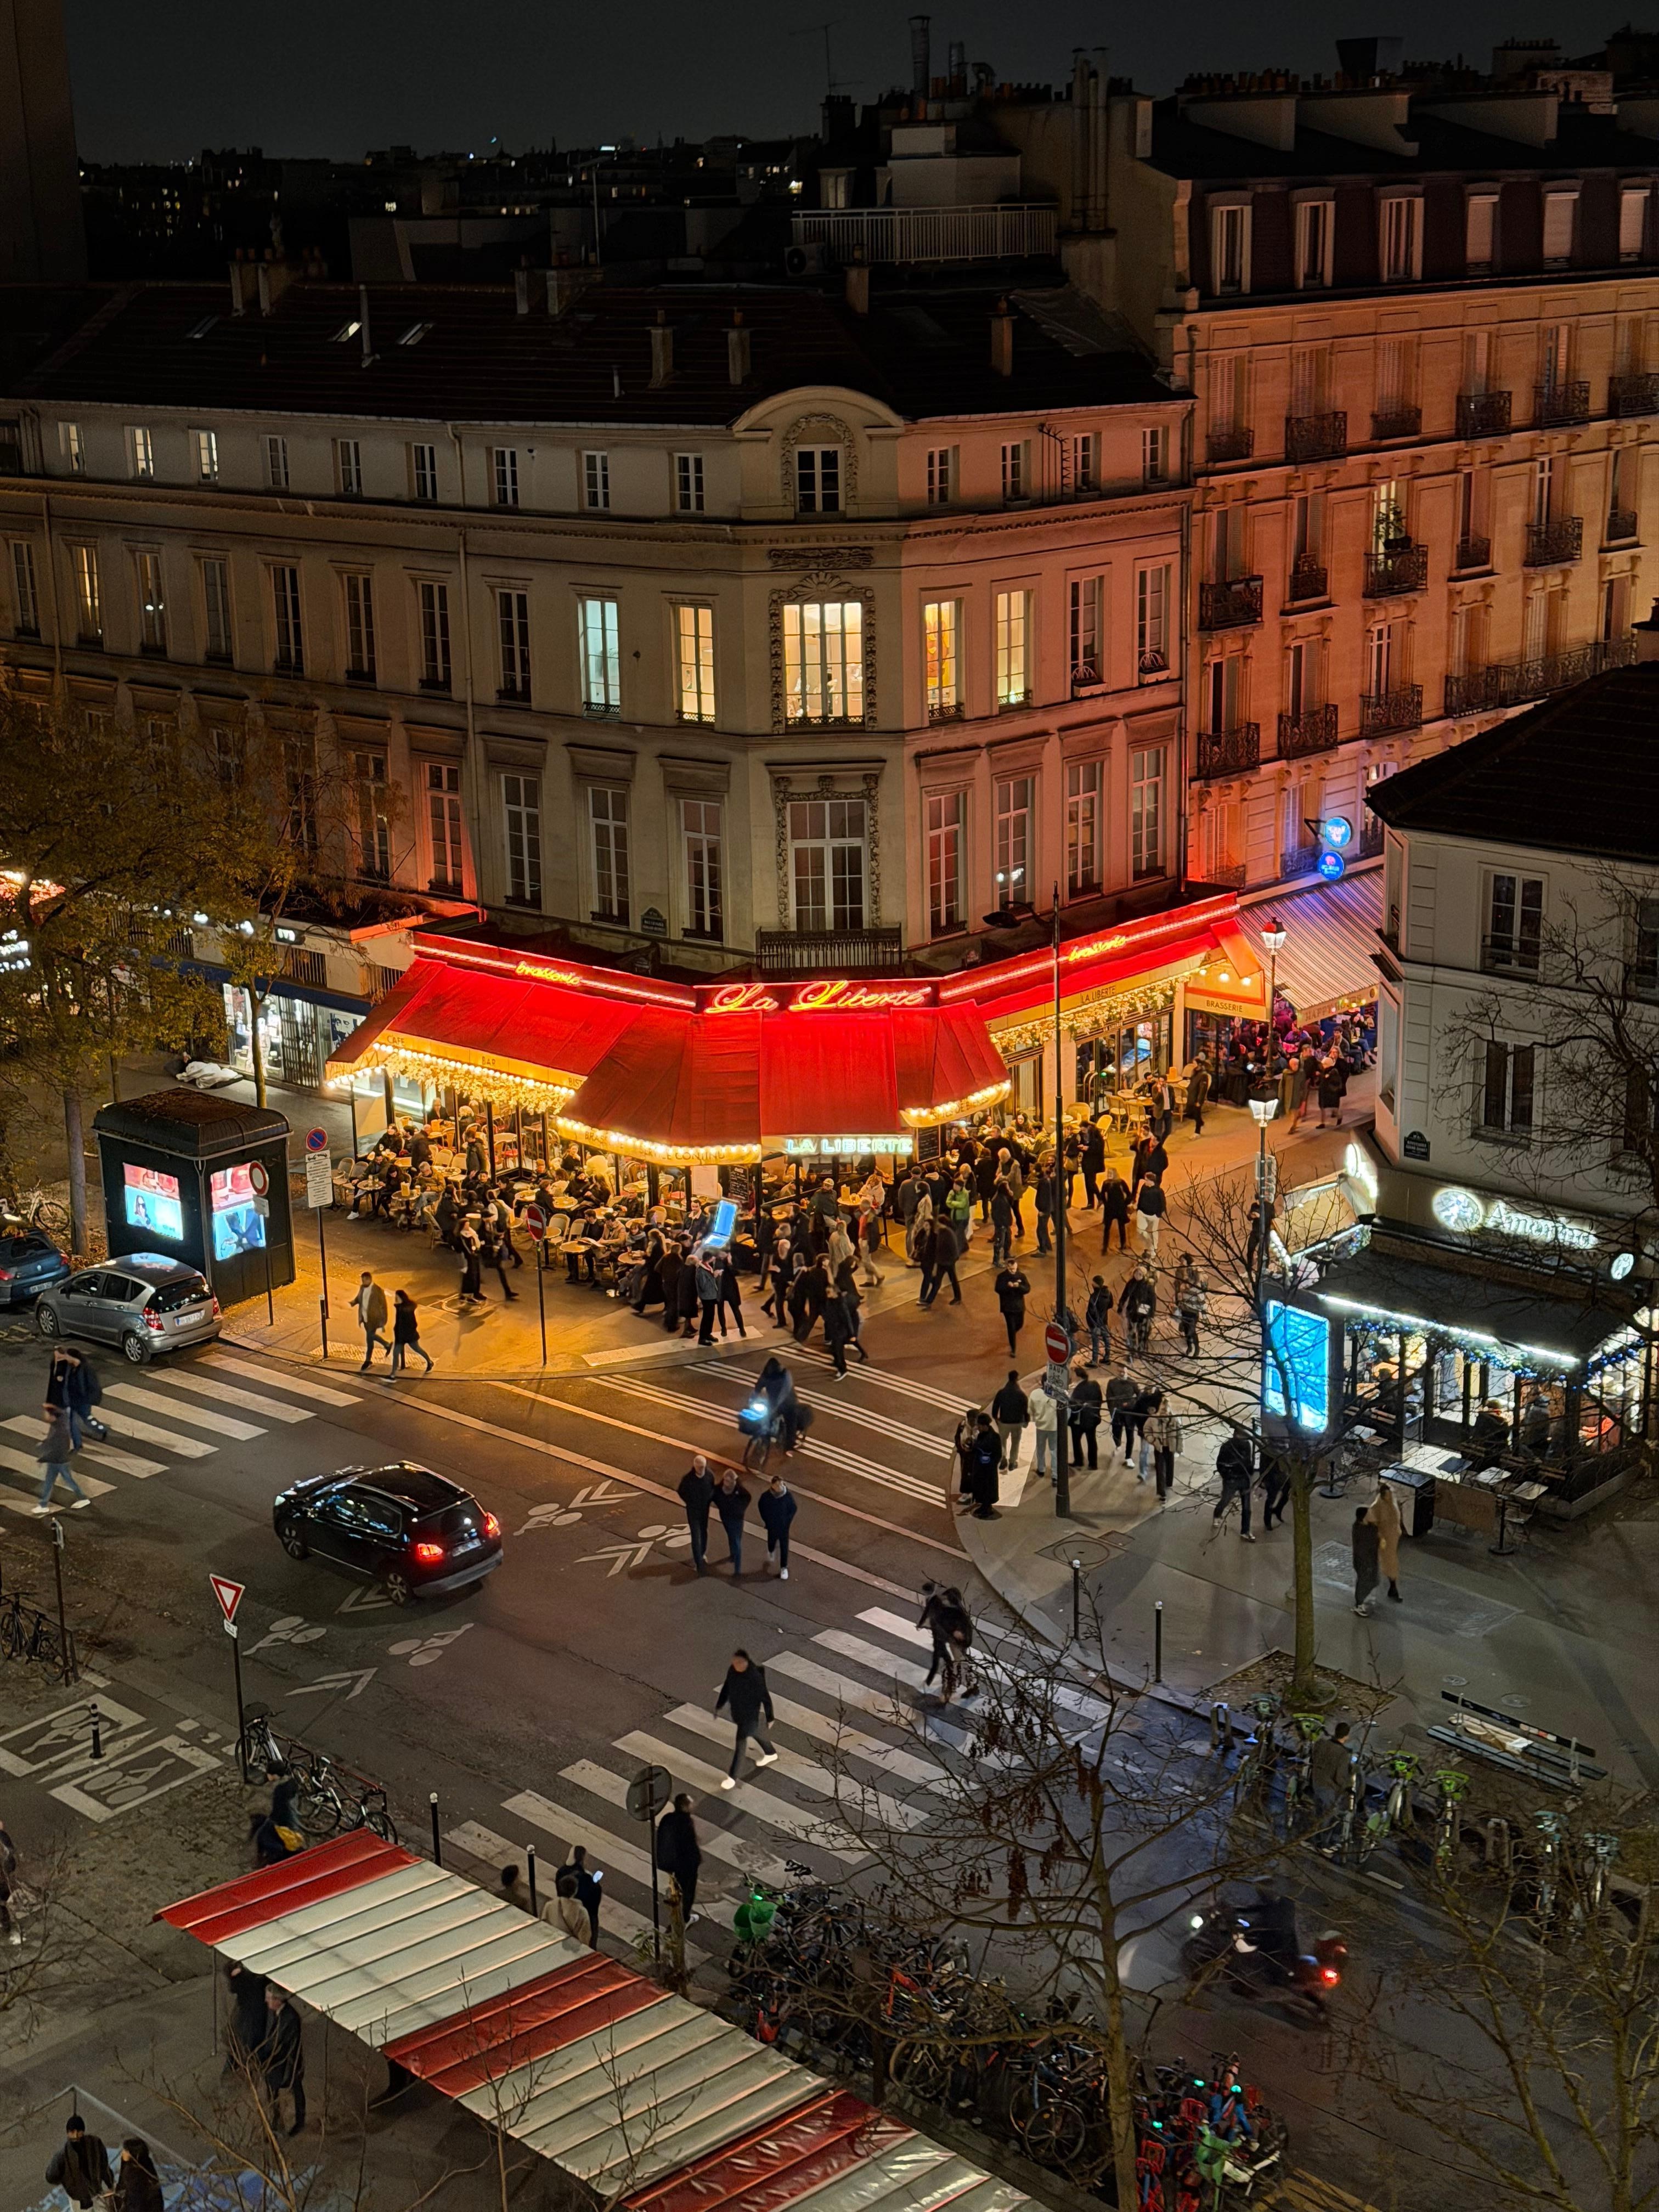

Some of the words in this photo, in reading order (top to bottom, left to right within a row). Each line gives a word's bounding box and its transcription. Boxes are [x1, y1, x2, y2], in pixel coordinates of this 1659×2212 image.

[705, 983, 778, 1013] La
[789, 980, 931, 1011] Liberté
[1206, 1000, 1243, 1012] BRASSERIE
[482, 1056, 495, 1065] BAR
[787, 1138, 816, 1153] LA
